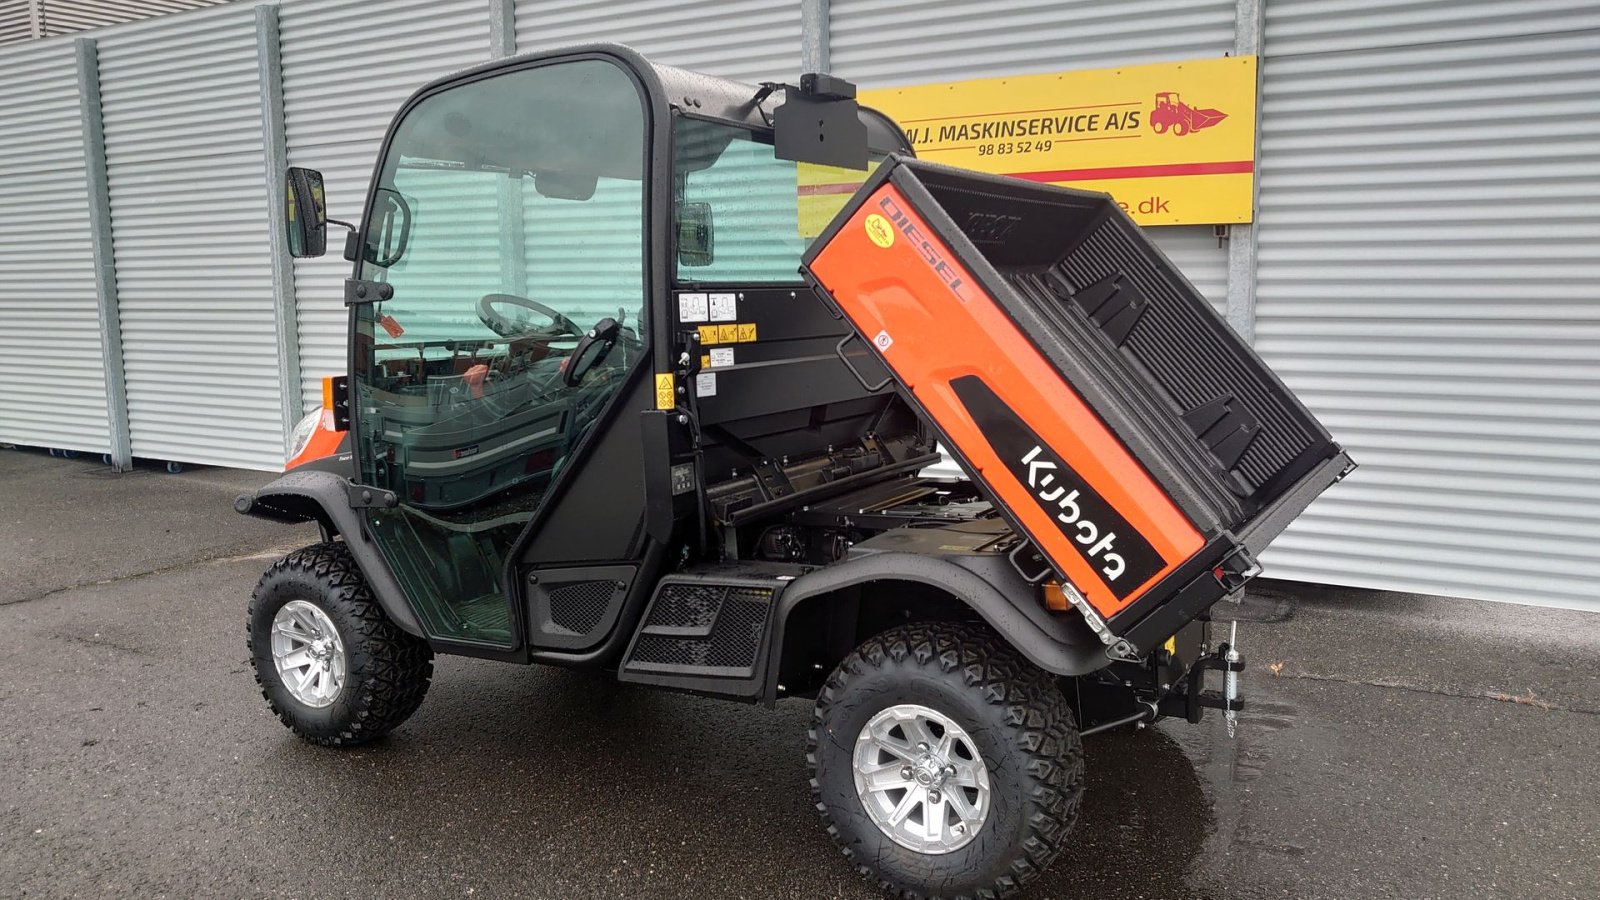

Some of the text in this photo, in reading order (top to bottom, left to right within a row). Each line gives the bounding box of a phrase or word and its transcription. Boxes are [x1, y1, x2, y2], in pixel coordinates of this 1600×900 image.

[938, 114, 1100, 142] MASKINSERVICE
[1104, 111, 1141, 131] A/S
[978, 140, 1052, 156] 98 83 52 49
[880, 196, 966, 303] DIESEL
[1020, 445, 1126, 582] Kubota
